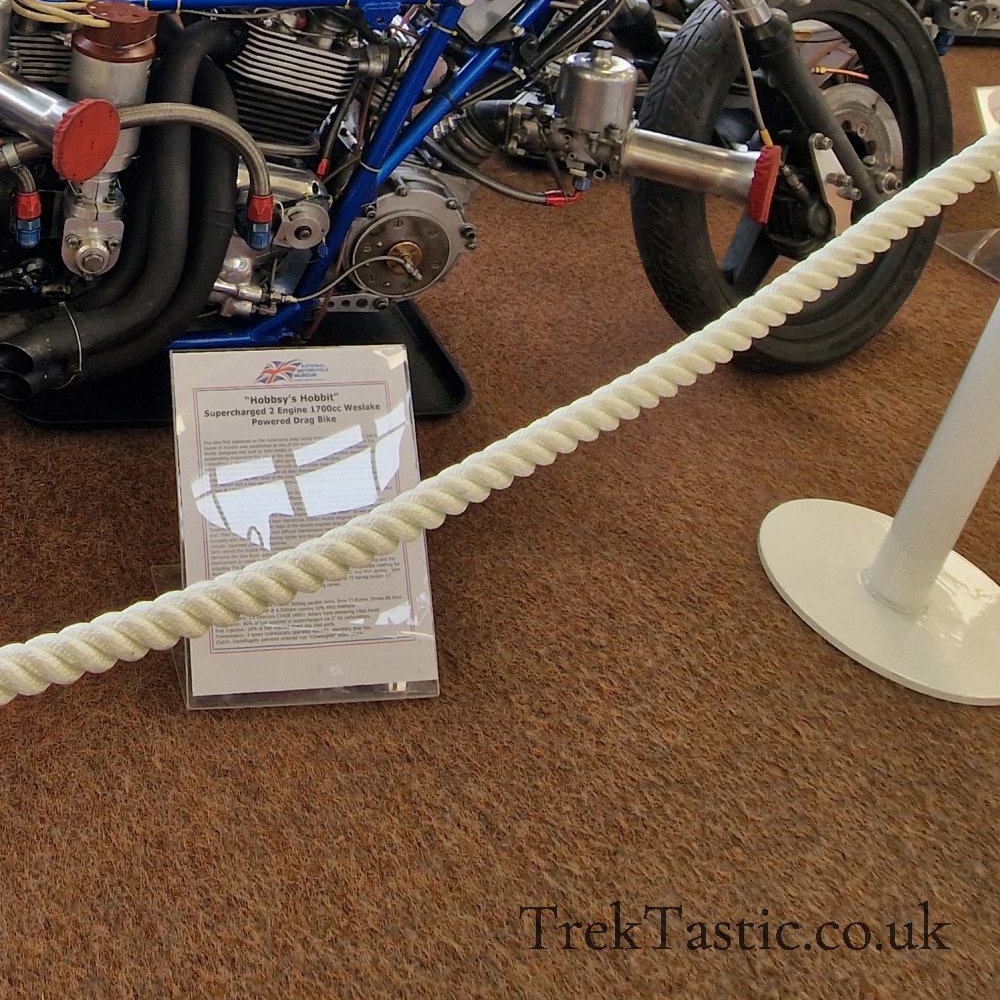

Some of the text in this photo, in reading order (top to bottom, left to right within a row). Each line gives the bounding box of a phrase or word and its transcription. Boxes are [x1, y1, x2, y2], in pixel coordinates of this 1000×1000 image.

[244, 393, 339, 405] "Hobbsy's Hobbit"
[204, 408, 267, 418] Supercharged
[278, 406, 308, 416] Engine
[310, 405, 342, 413] 1700cc
[344, 403, 381, 411] Weslake
[252, 415, 337, 426] Powered Drag Bike
